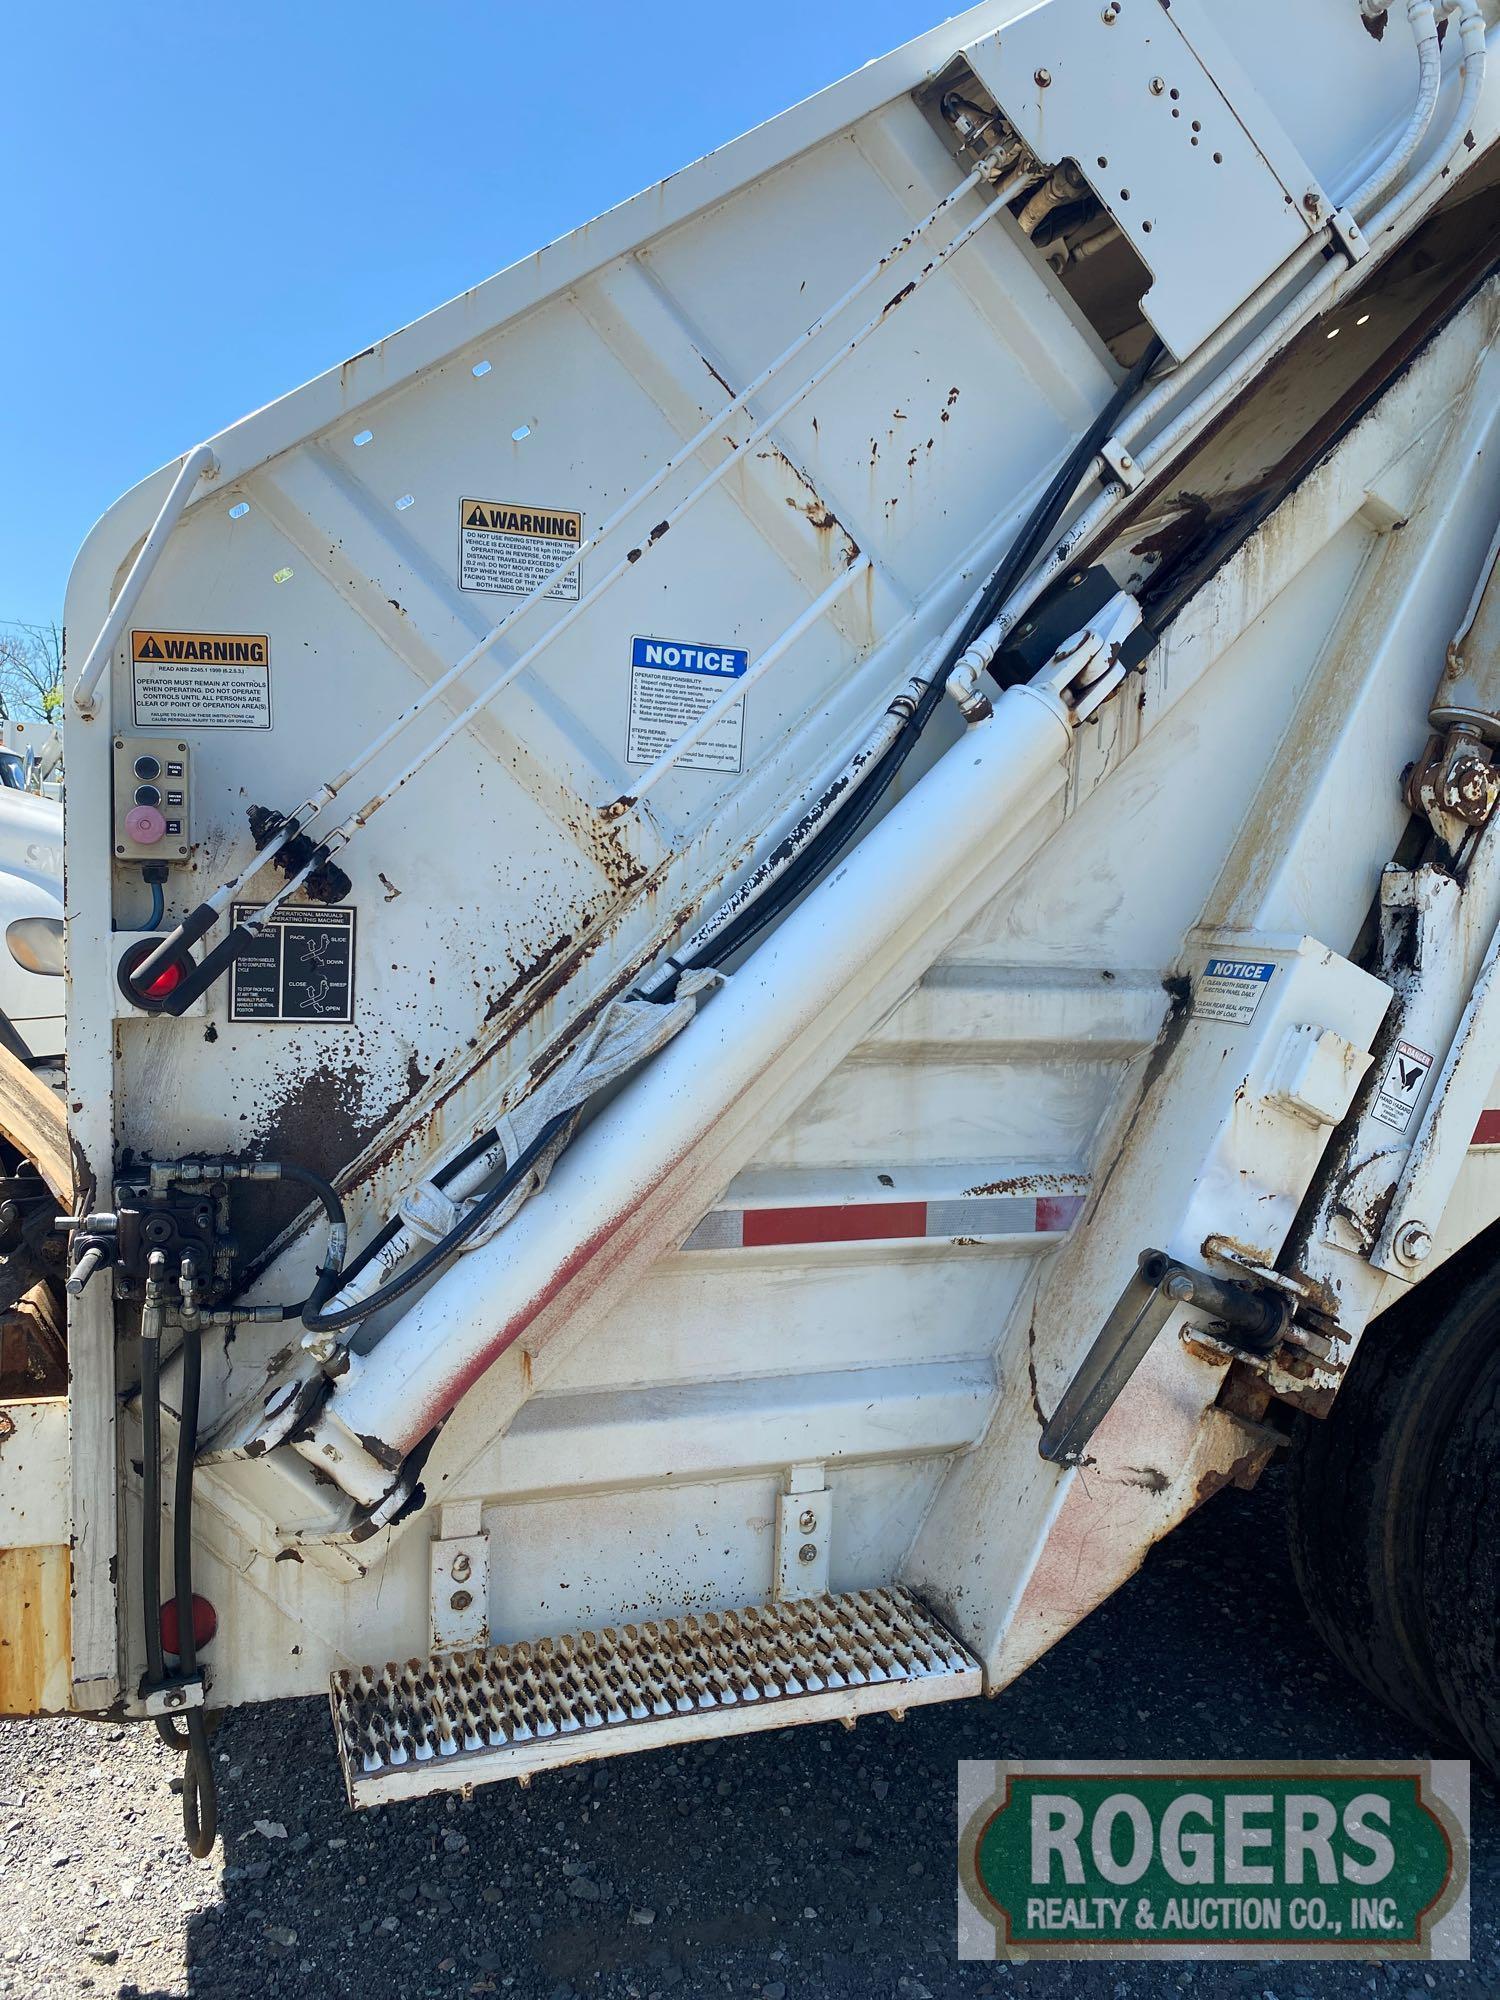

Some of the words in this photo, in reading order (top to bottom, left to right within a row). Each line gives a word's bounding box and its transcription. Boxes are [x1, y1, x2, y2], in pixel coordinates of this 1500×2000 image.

[490, 510, 576, 537] WARNING
[471, 547, 504, 555] OPERATING
[499, 542, 531, 551] EXCEEDING
[467, 553, 494, 561] DISTANCE
[498, 556, 526, 564] TRAVELED
[164, 640, 263, 662] WARNING
[646, 645, 735, 673] NOTICE
[1212, 963, 1265, 978] NOTICE
